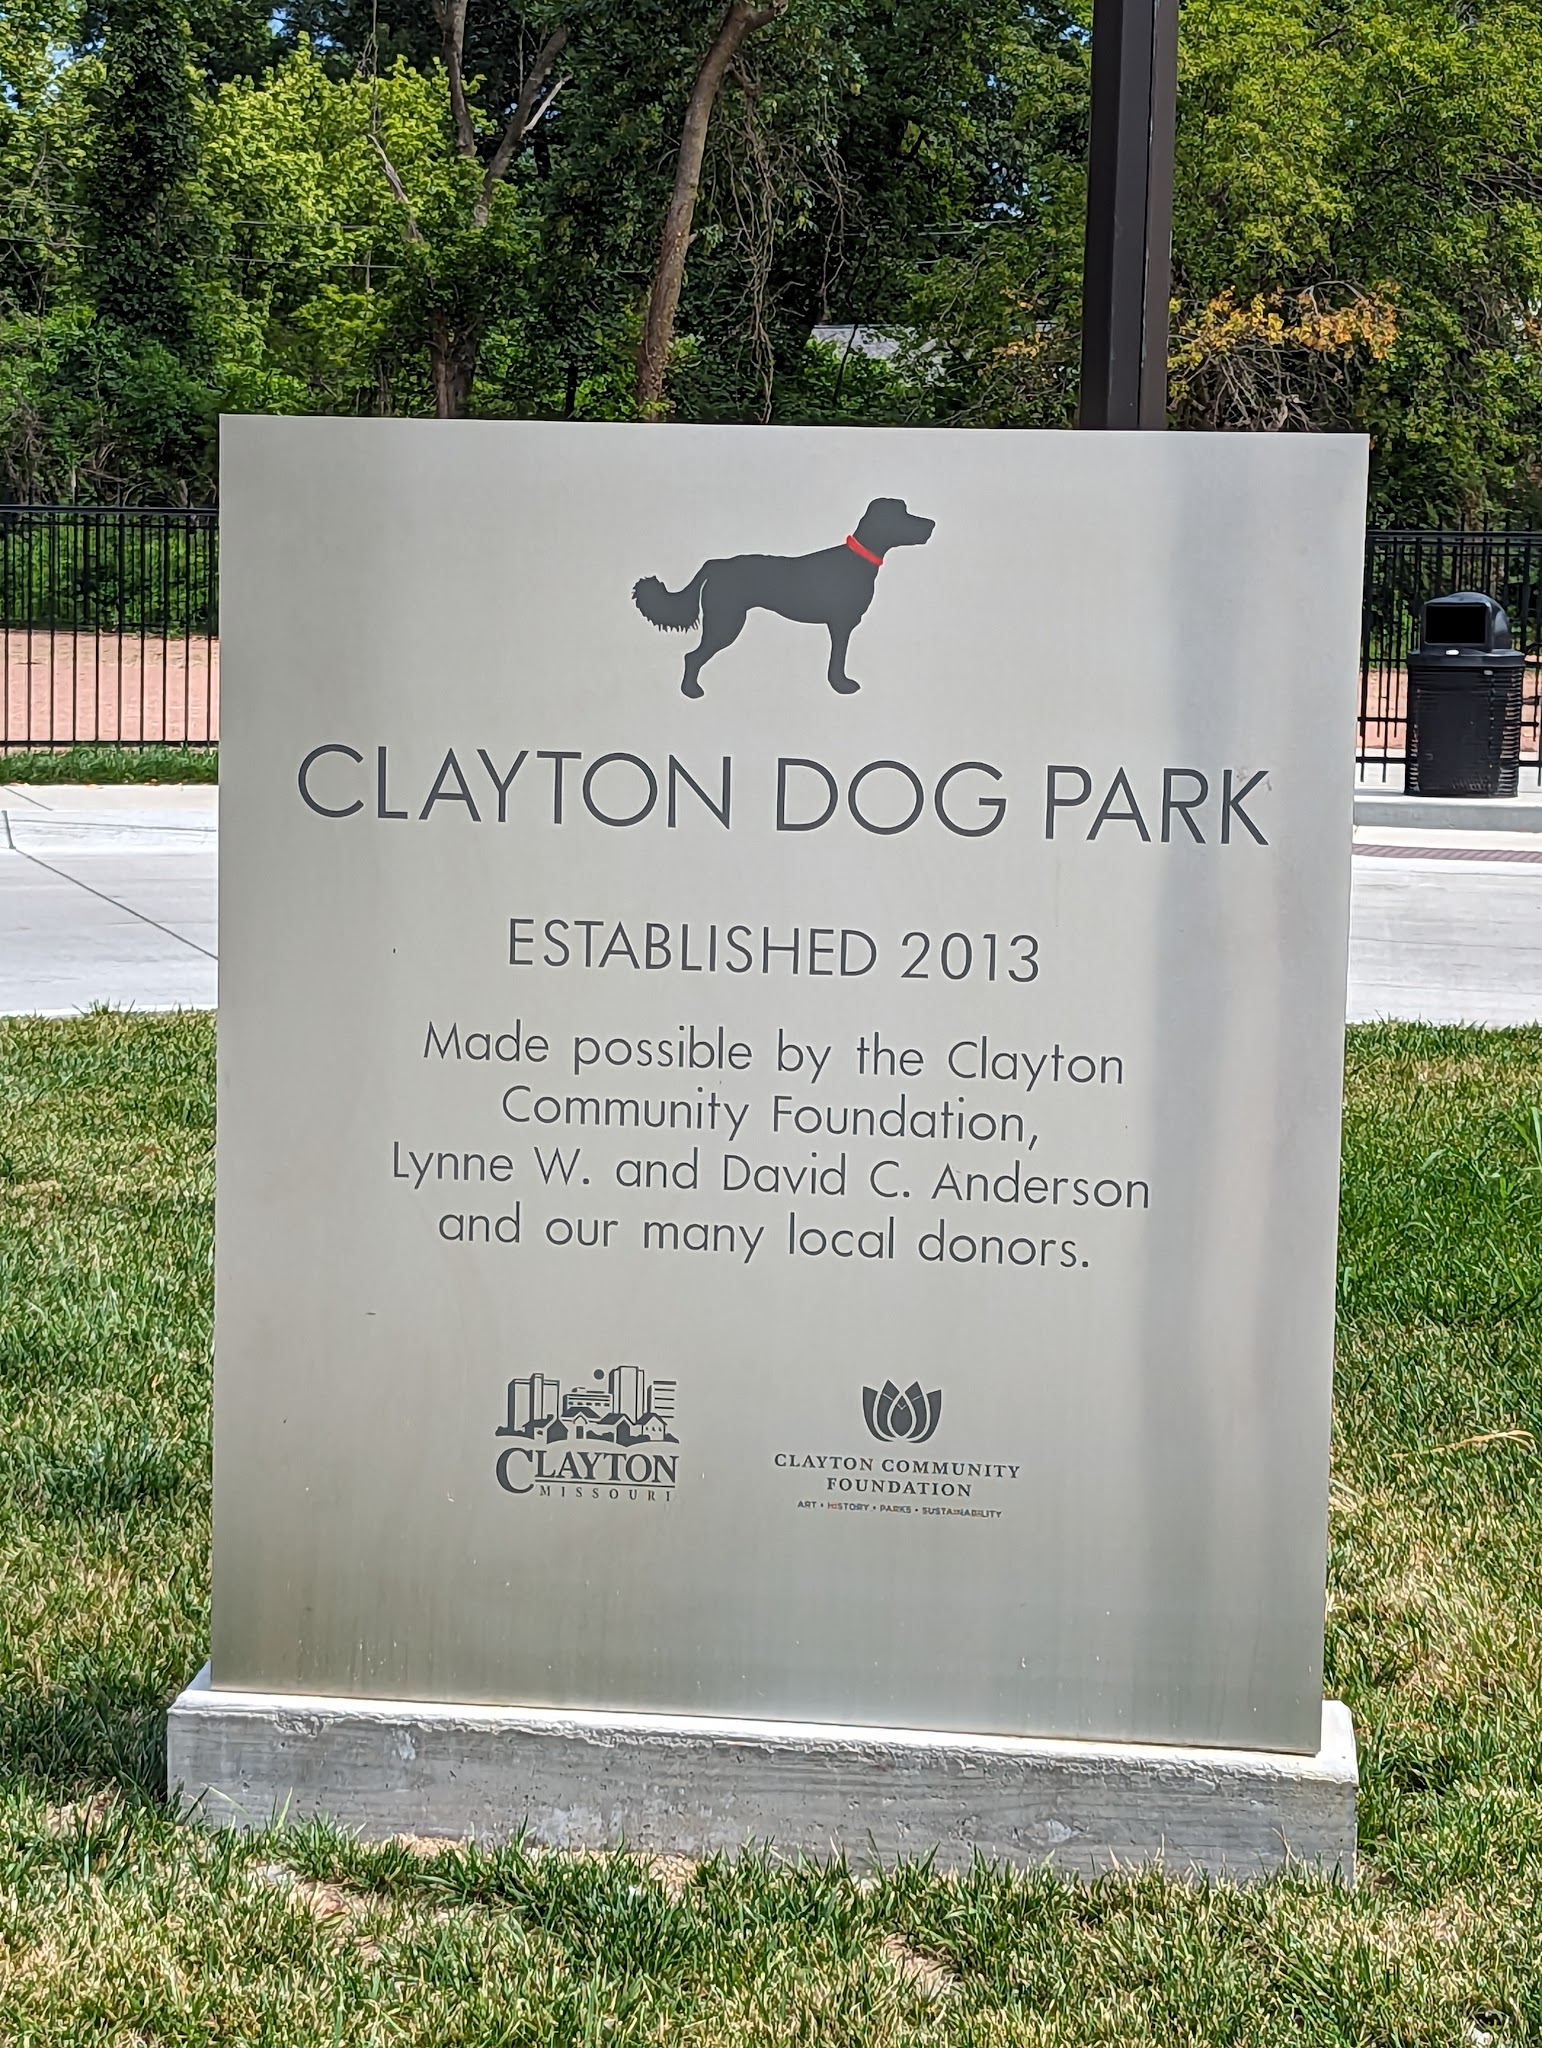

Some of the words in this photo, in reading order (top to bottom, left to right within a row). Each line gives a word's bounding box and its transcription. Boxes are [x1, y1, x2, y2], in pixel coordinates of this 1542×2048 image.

[297, 743, 732, 830] CLAYTON
[776, 757, 1007, 838] DOG
[1045, 764, 1270, 846] PARK
[509, 917, 877, 977] ESTABLISHED
[900, 931, 1039, 983] 2013
[423, 1018, 549, 1063] Made
[574, 1024, 753, 1076] possible
[777, 1028, 832, 1085] by
[856, 1031, 924, 1077] the
[948, 1035, 1123, 1093] Clayton
[502, 1084, 750, 1142] Community
[773, 1093, 1038, 1151] Foundation,
[393, 1140, 514, 1190] Lynne
[533, 1146, 590, 1186] W.
[615, 1146, 699, 1190] and
[723, 1151, 846, 1196] David
[869, 1160, 910, 1198] C.
[930, 1159, 1149, 1209] Anderson
[438, 1200, 521, 1244] and
[545, 1217, 619, 1248] our
[643, 1221, 765, 1264] many
[789, 1211, 895, 1259] local
[918, 1218, 1089, 1268] donors.
[495, 1447, 680, 1494] CLAYTON
[539, 1485, 672, 1502] MISSOURI
[774, 1453, 874, 1472] CLAYTON
[881, 1458, 1020, 1479] COMMUNITY
[826, 1477, 972, 1497] FOUNDATION
[797, 1500, 818, 1510] ART
